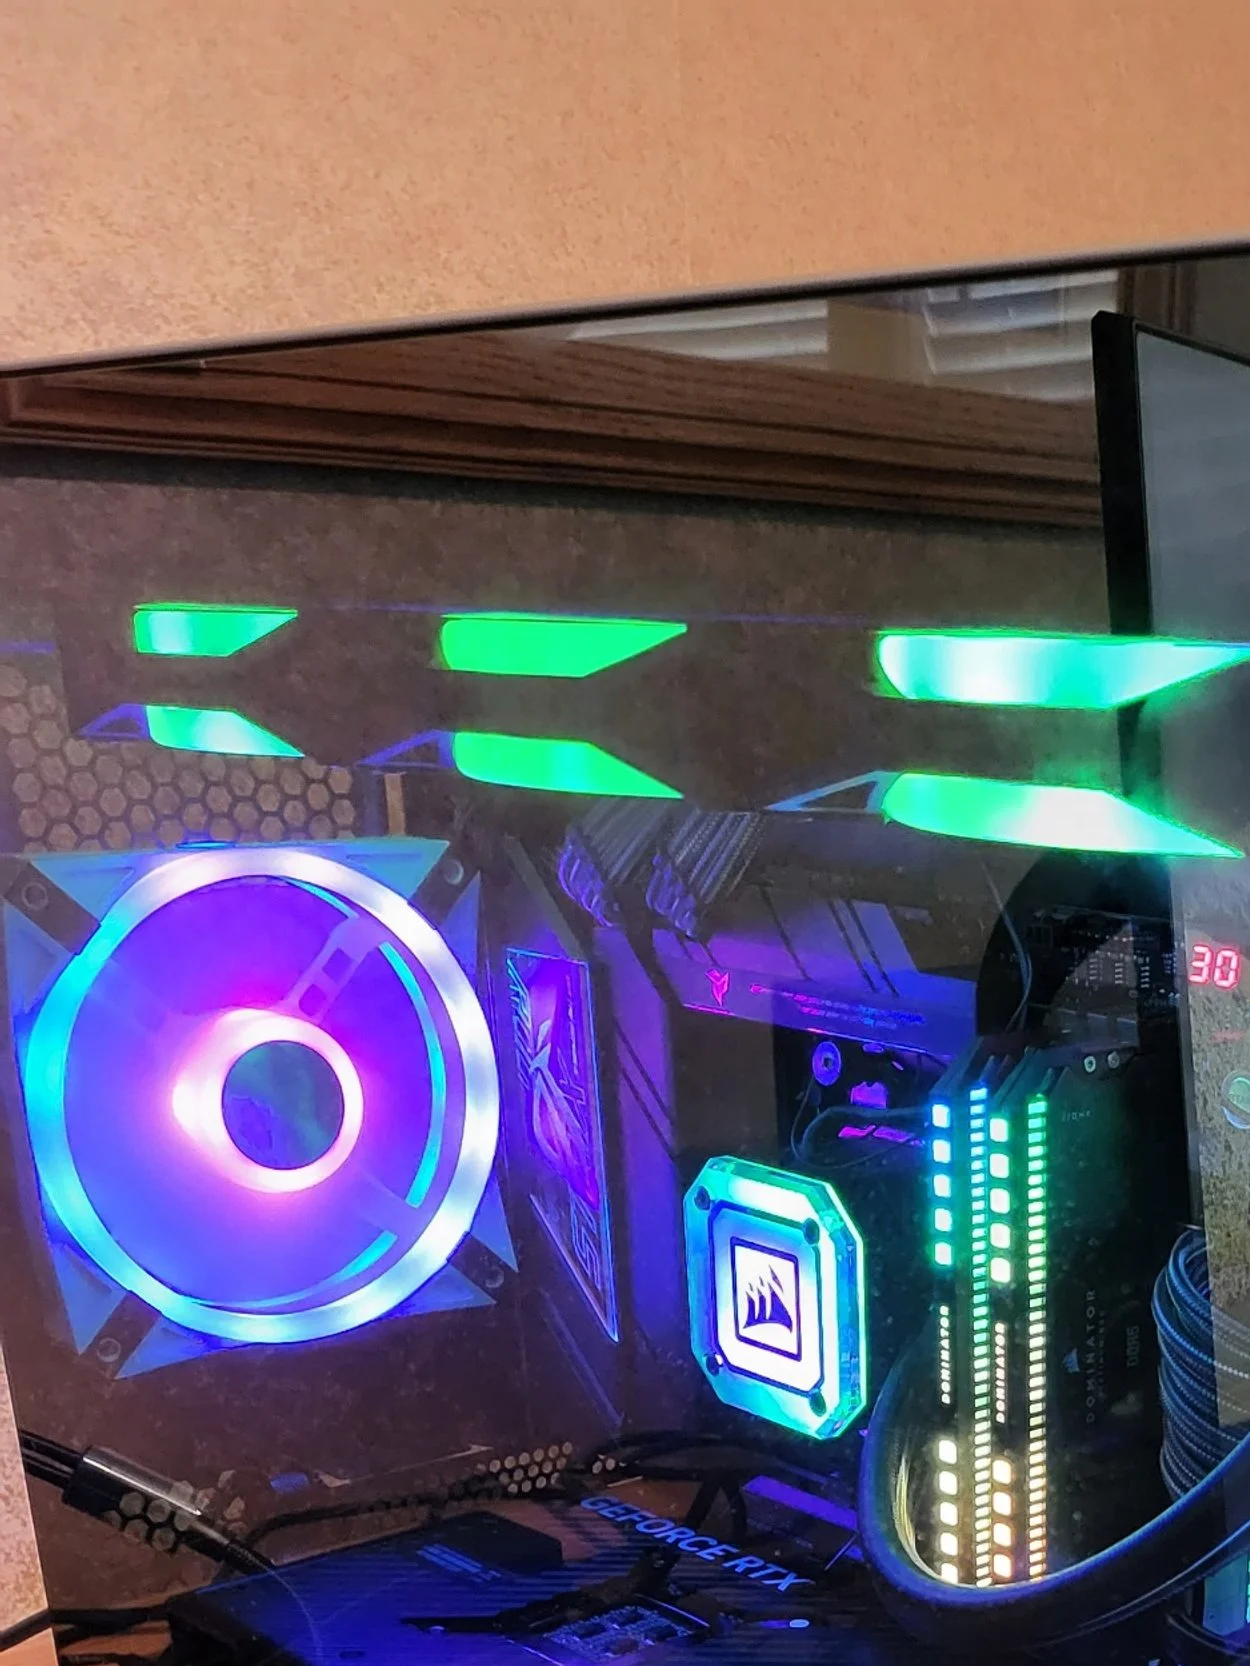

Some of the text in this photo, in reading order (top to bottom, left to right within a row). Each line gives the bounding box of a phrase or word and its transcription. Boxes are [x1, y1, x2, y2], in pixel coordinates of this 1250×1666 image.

[1189, 945, 1241, 989] 30
[939, 1305, 951, 1405] DOMINATOR
[994, 1322, 1006, 1424] DOMINATOR
[1085, 1288, 1097, 1424] DOMINATOR
[580, 1495, 815, 1592] GEFORCE RTX
